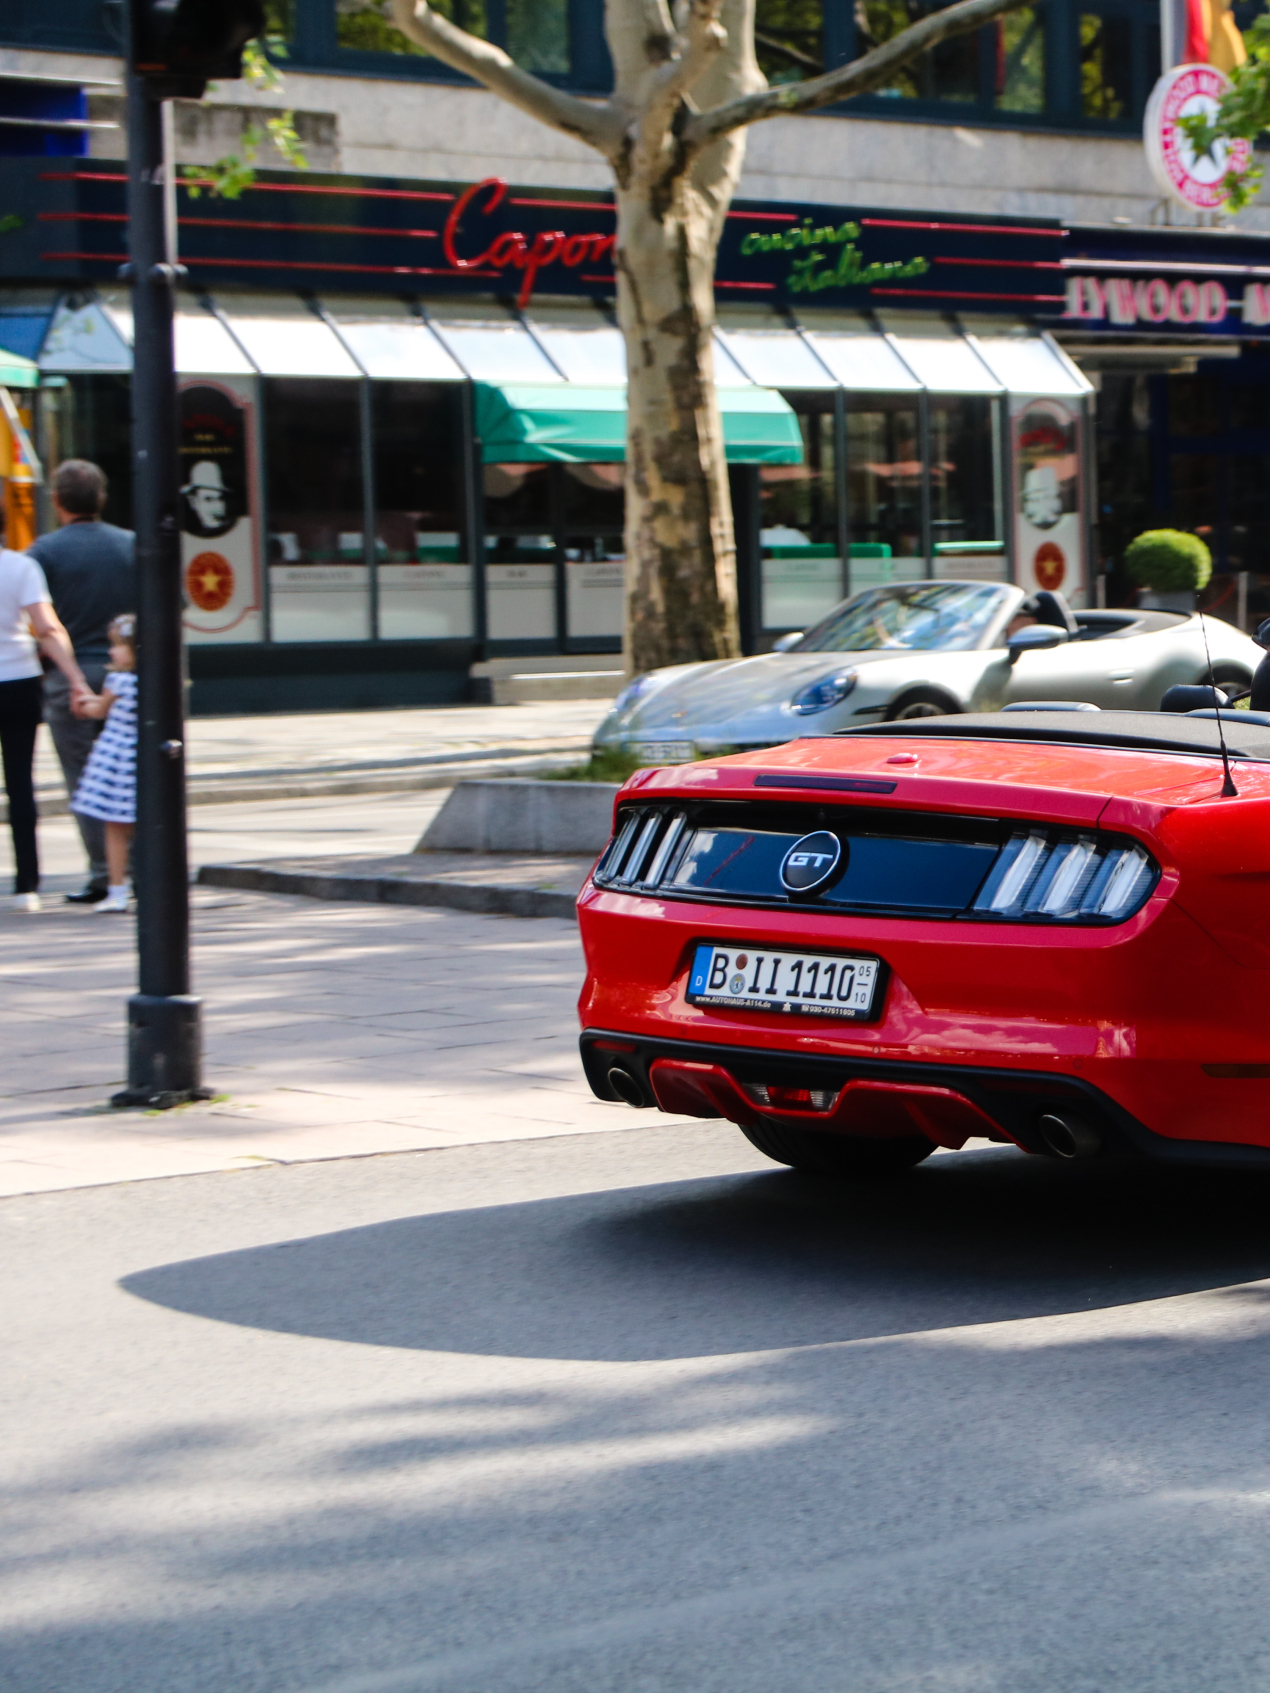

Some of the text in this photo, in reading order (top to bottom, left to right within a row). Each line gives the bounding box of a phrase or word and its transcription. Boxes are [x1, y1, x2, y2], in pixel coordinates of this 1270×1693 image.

[1060, 276, 1228, 325] LYWOOD
[788, 851, 834, 868] GT
[695, 975, 703, 987] D
[708, 953, 730, 990] B
[785, 959, 857, 1002] 1110
[854, 992, 867, 1005] 10
